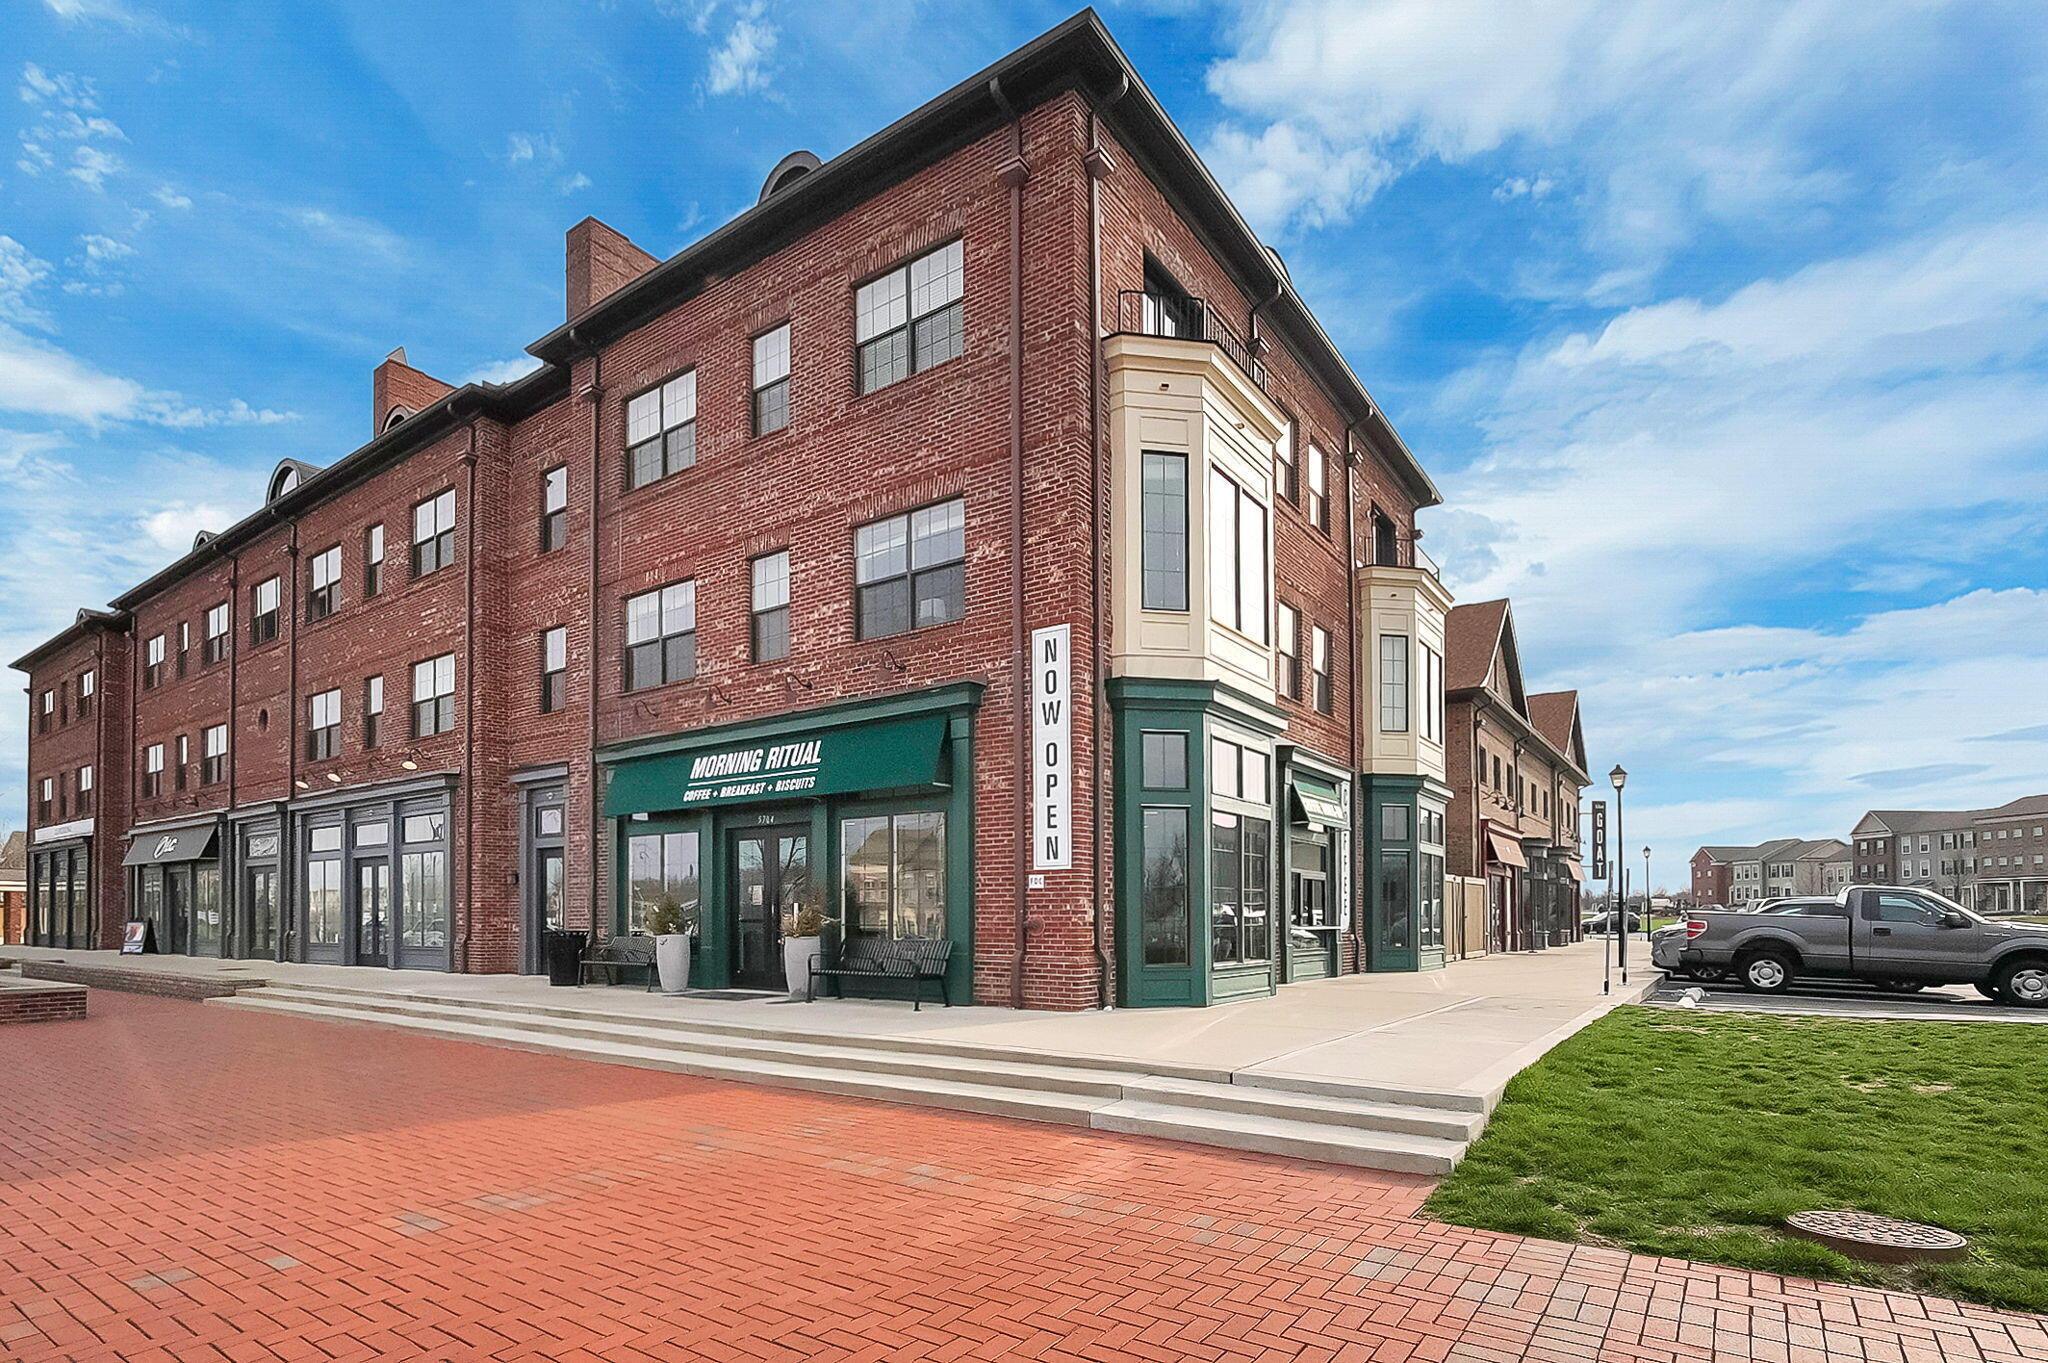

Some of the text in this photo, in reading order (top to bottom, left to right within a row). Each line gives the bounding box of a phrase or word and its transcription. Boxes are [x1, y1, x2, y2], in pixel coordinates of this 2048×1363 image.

[690, 740, 821, 779] MORNING RITUAL
[1042, 638, 1061, 861] NOW OPEN
[683, 788, 712, 801] COFFEE
[720, 782, 767, 798] BREAKFAST
[775, 776, 816, 792] BISCUITS
[1596, 812, 1604, 878] GOAT
